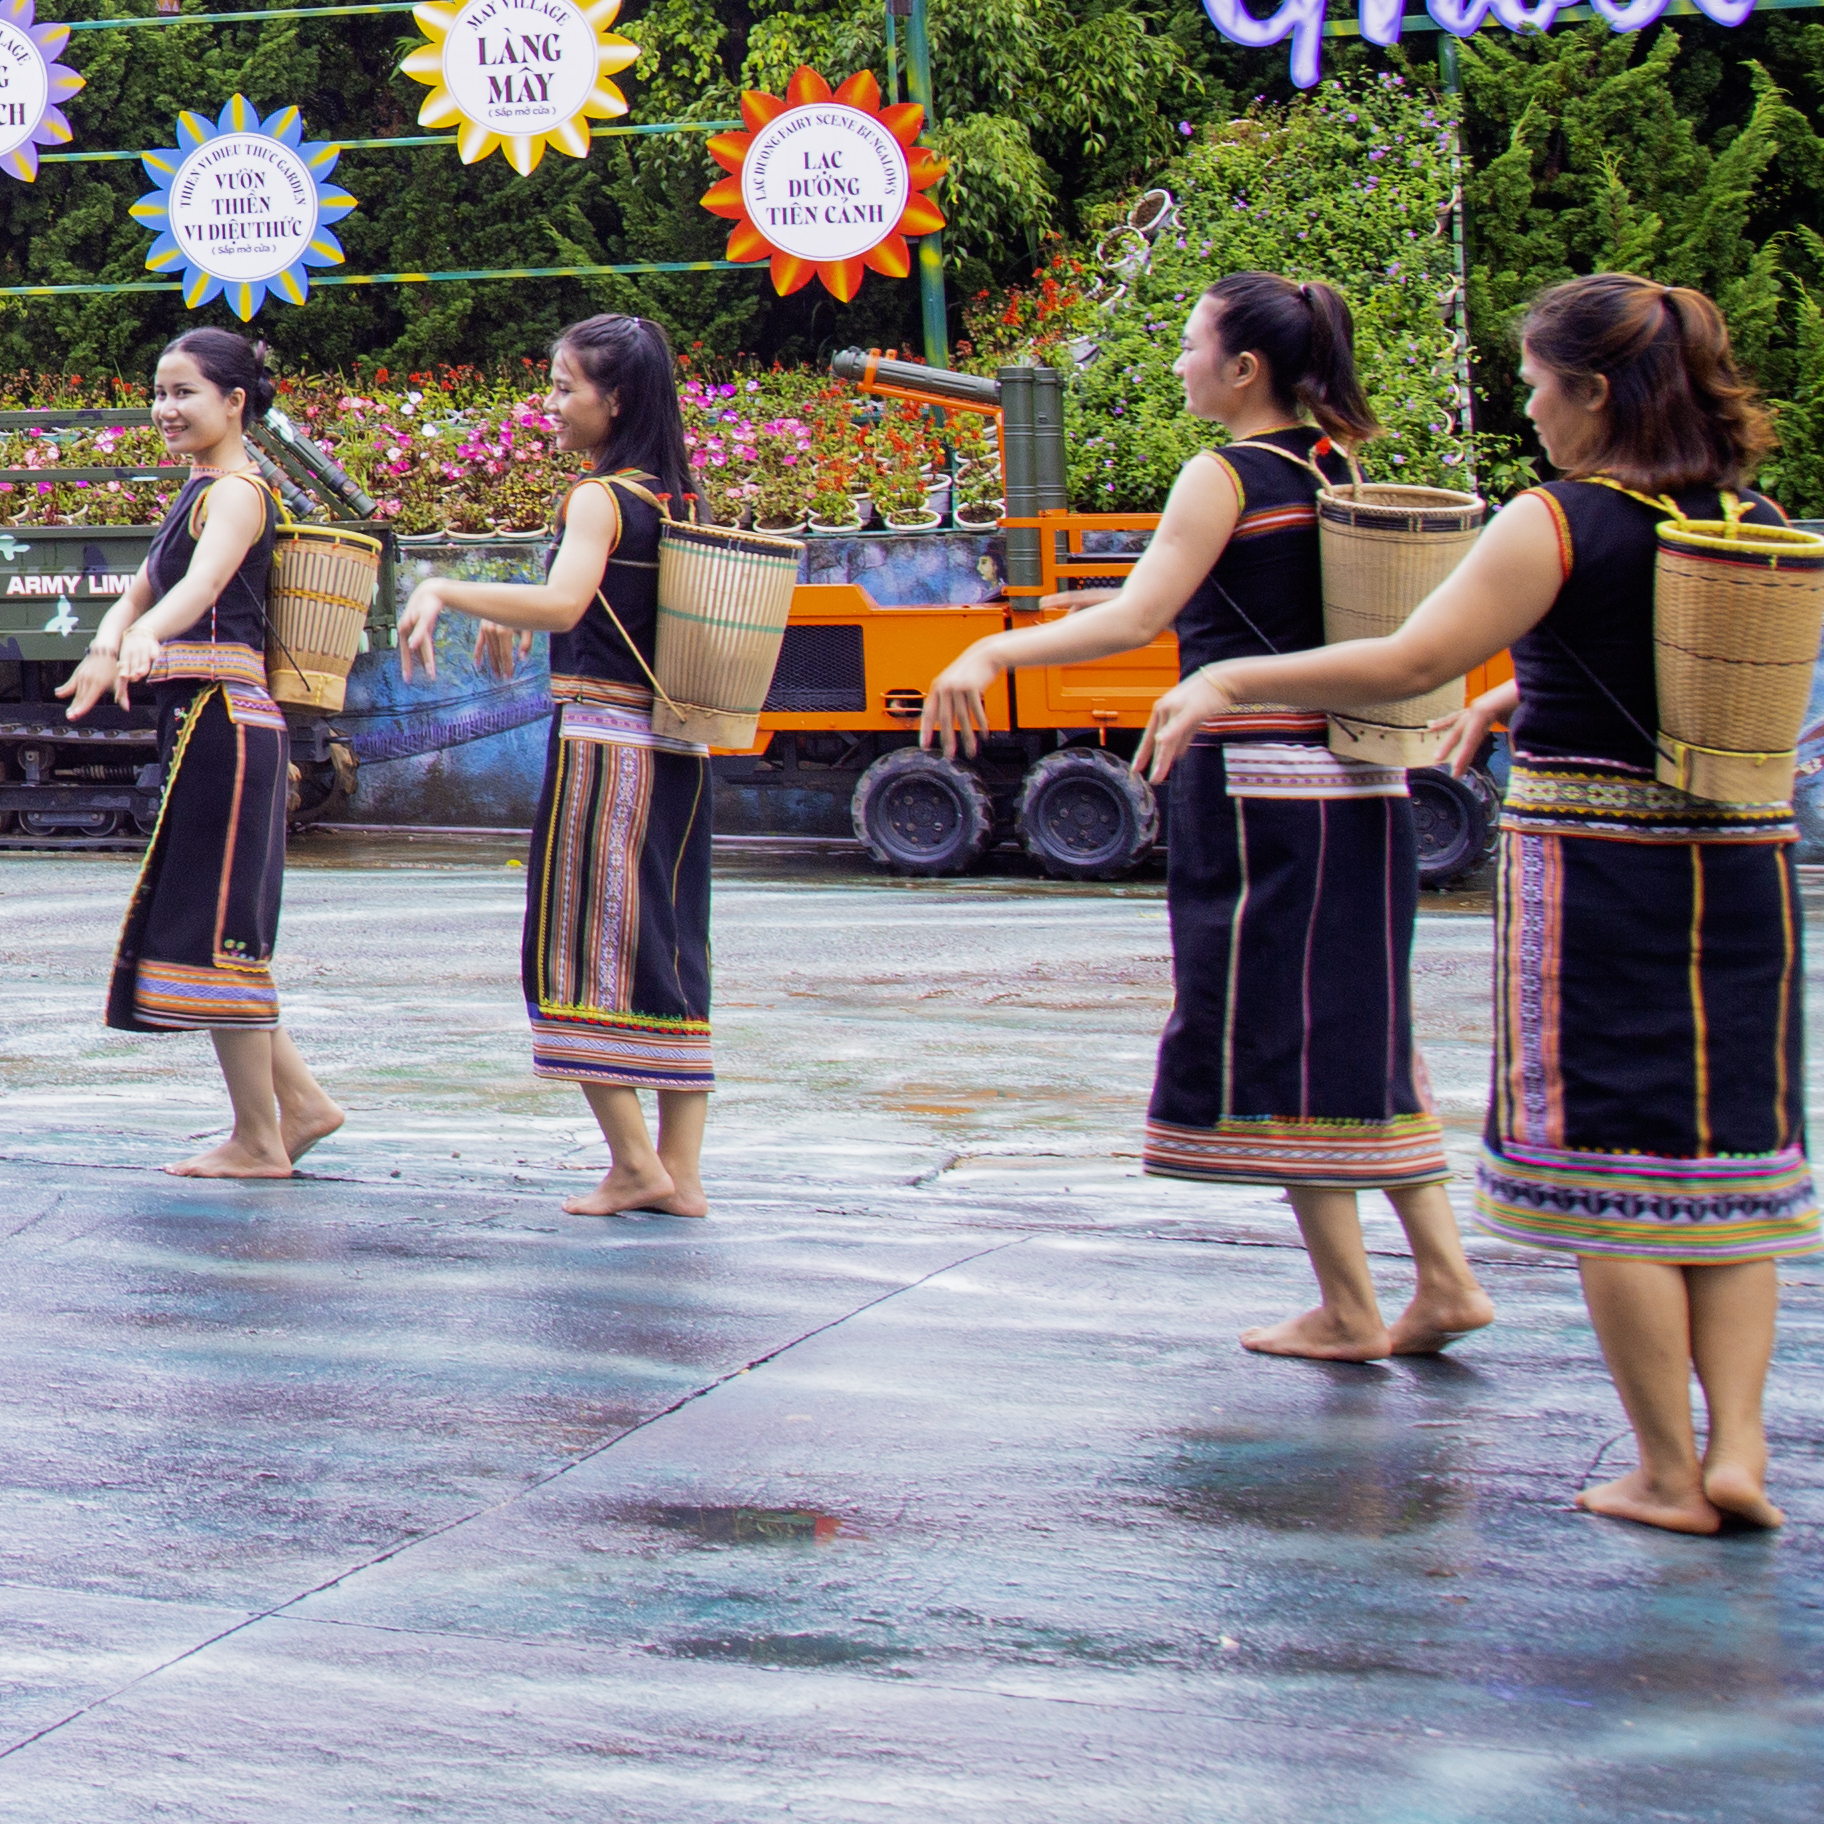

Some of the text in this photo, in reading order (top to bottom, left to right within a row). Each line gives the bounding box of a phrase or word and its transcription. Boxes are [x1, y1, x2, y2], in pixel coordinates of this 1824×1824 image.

[466, 1, 497, 31] MAY
[478, 27, 562, 66] LÀNG
[487, 67, 555, 104] MÂY
[754, 114, 897, 201] LAC DUONG FAIRY SCENE BUNGALOWS
[803, 151, 843, 175] LẠC
[180, 144, 306, 208] THIEN VI DIEU THUC GARDEN
[215, 168, 265, 189] VƯỜN
[789, 175, 860, 197] DƯƠNG
[211, 190, 270, 215] THIỀN
[766, 197, 884, 225] TIÊN CẢNH
[184, 225, 202, 241] VI
[6, 575, 82, 596] ARMY
